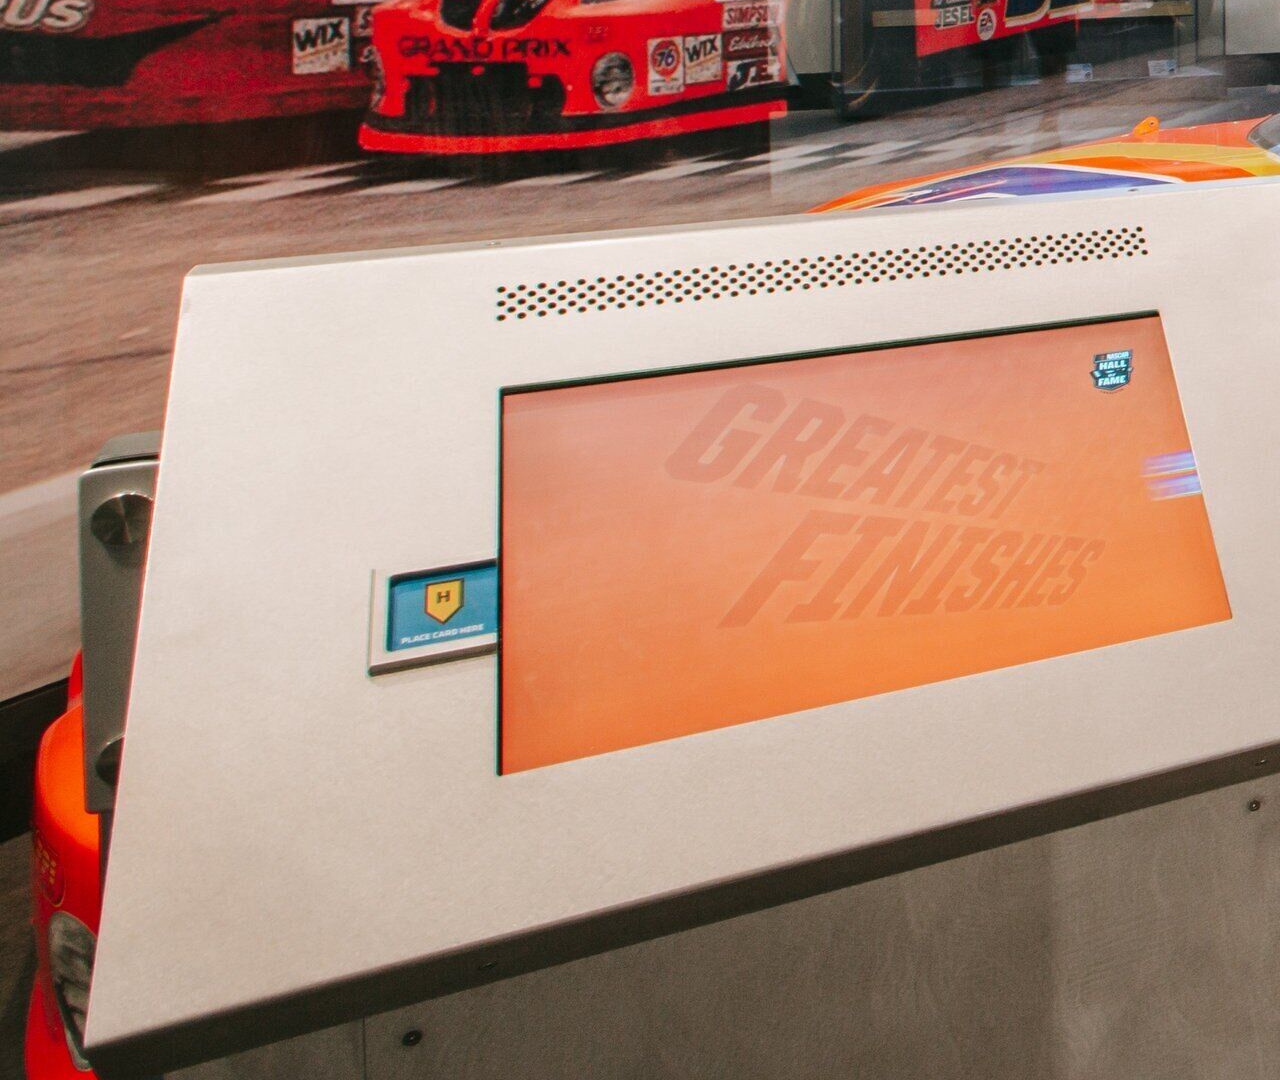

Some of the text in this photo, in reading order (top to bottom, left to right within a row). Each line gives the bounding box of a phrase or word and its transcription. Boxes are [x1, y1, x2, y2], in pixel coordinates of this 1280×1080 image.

[294, 21, 345, 54] WIX
[502, 38, 571, 58] PRIX
[655, 50, 675, 67] 76
[685, 37, 718, 62] WIX
[1099, 360, 1127, 370] HALL
[1098, 375, 1126, 387] FAME
[663, 383, 1046, 517] GREATEST
[717, 510, 1107, 630] FINISHES
[401, 623, 484, 644] PLACE CARD HERE
